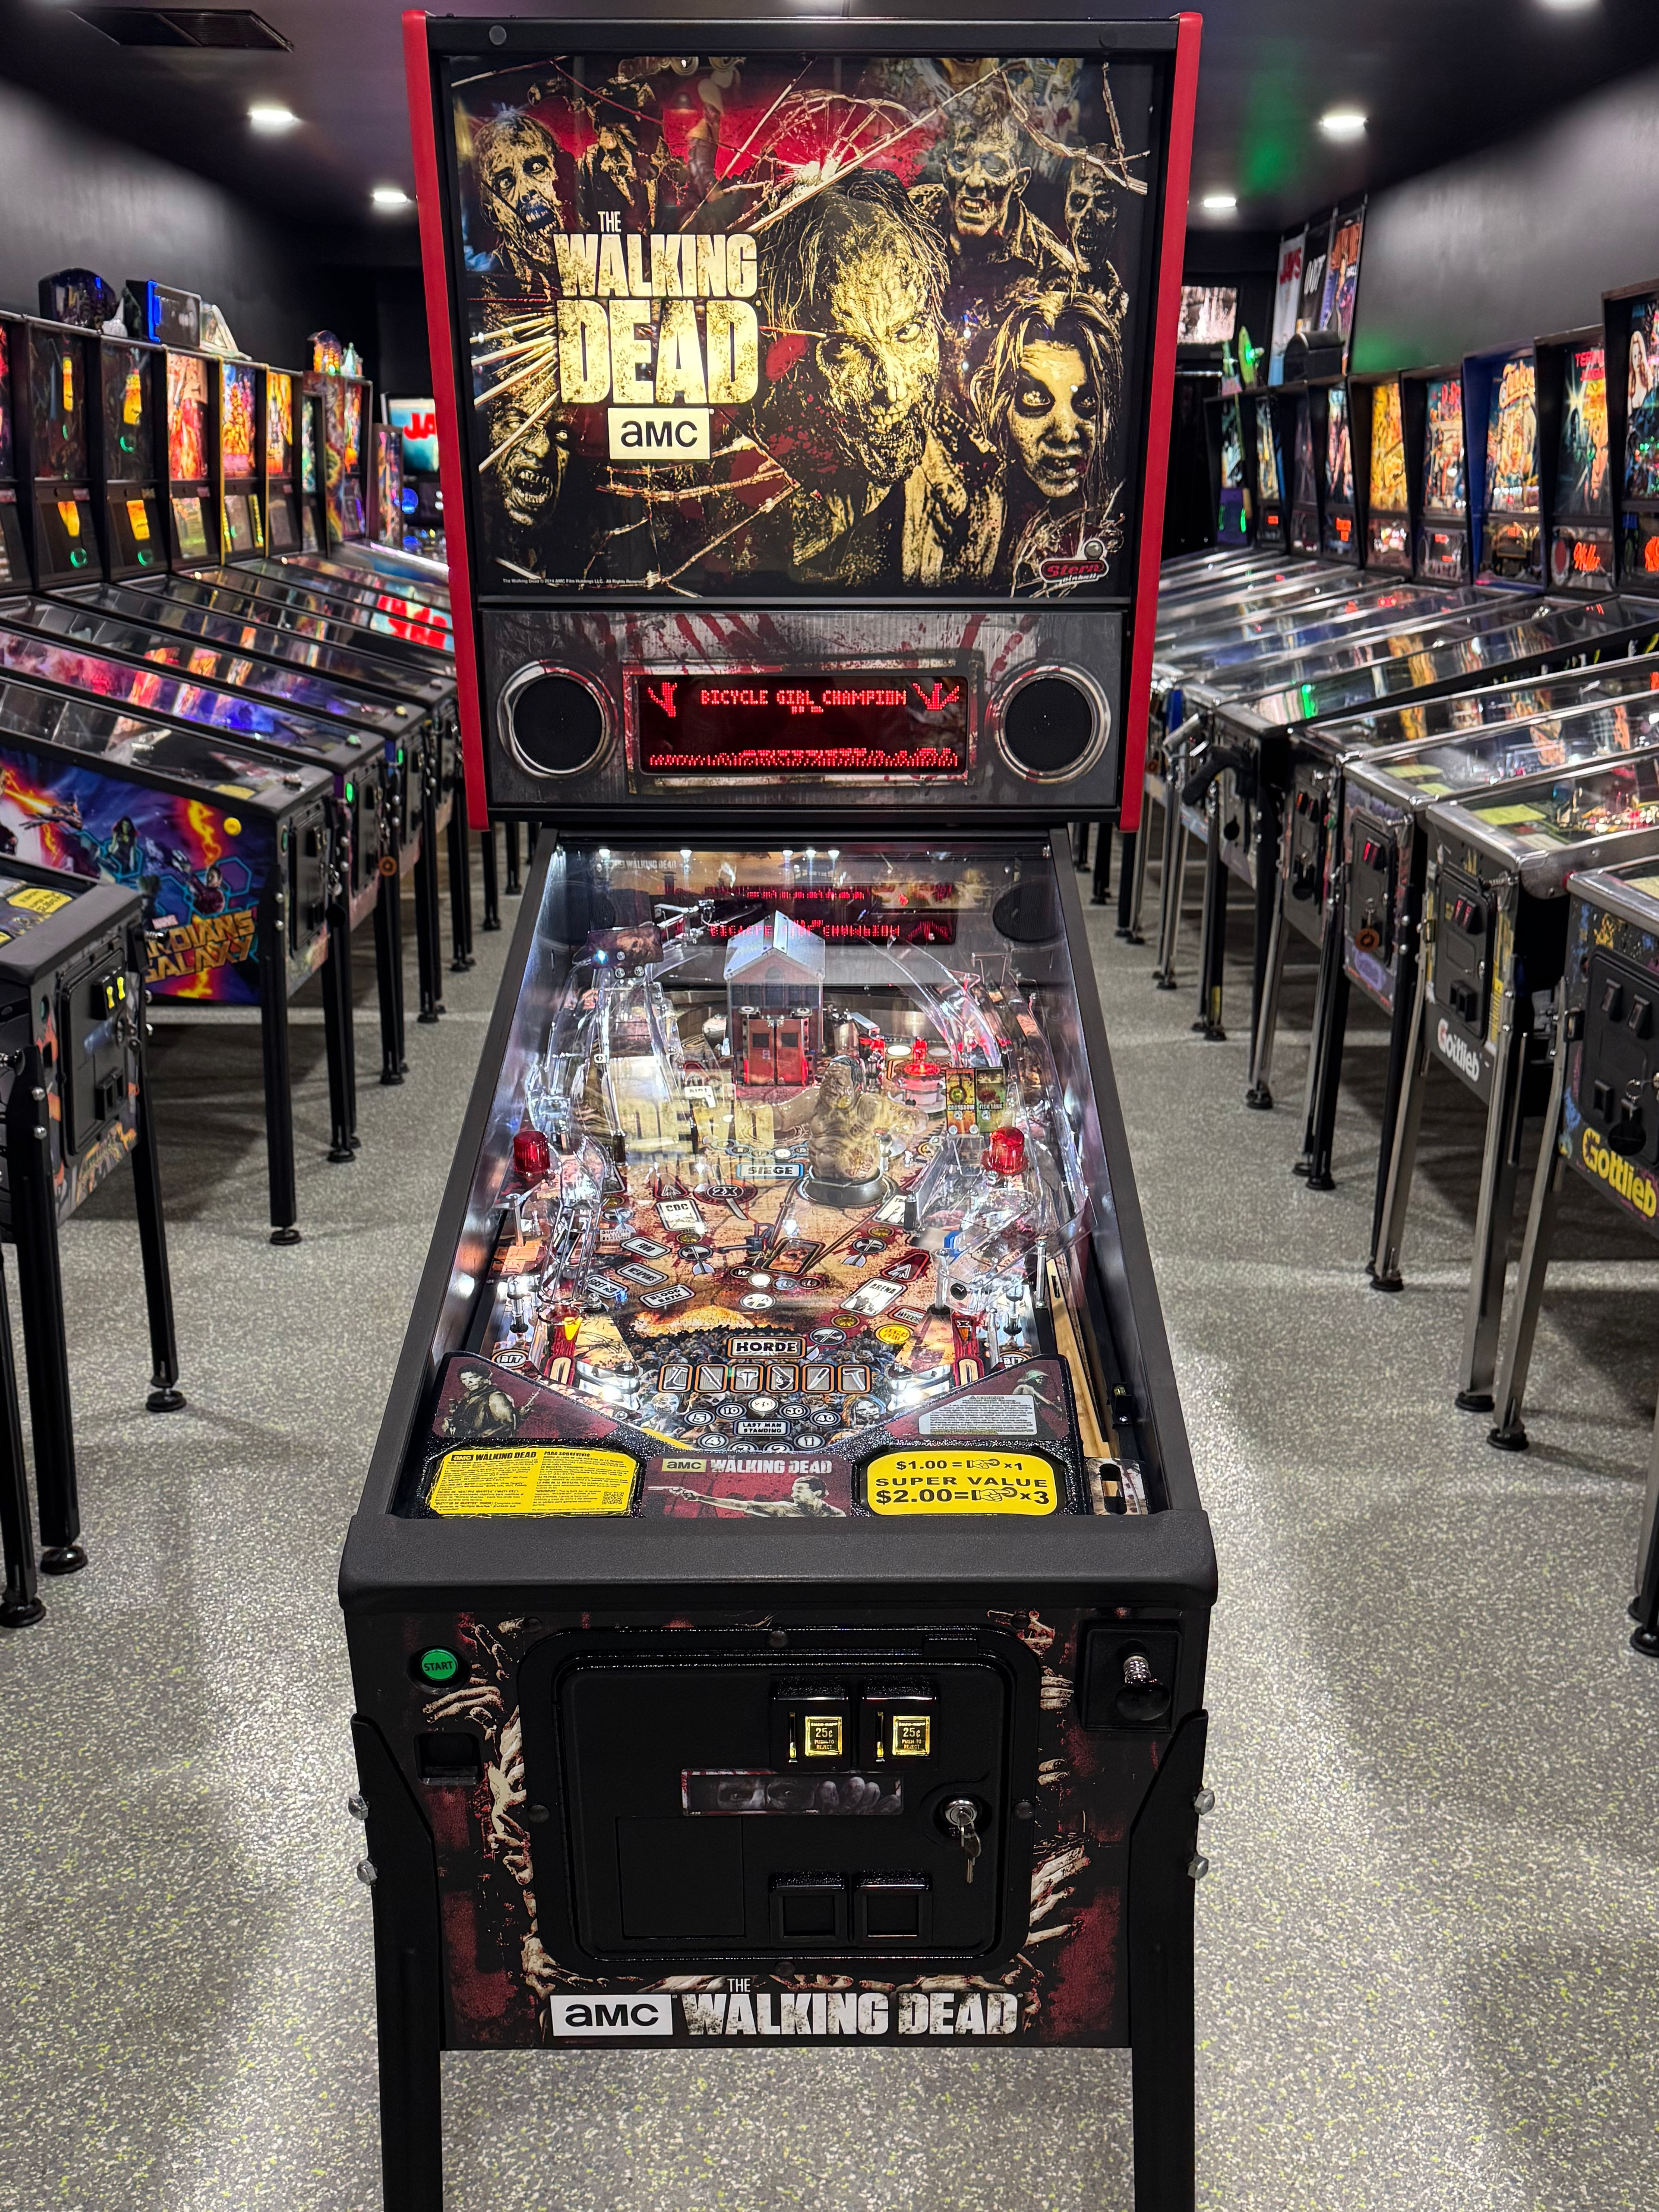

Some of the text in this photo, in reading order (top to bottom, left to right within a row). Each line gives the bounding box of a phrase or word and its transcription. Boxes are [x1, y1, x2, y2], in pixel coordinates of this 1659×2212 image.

[598, 211, 621, 232] THE
[553, 234, 757, 297] WALKING
[557, 300, 759, 404] DEAD
[403, 413, 436, 440] JA
[1046, 564, 1104, 577] Stern
[701, 690, 907, 705] BICYCLE GIRL CHAMPION
[748, 1166, 793, 1175] SIEGE
[1582, 1127, 1657, 1218] Gottlieb
[712, 1187, 737, 1196] 2X
[665, 1203, 689, 1212] CDC
[636, 1242, 656, 1252] FOOD
[627, 1267, 657, 1282] WEAPONS
[869, 1283, 897, 1294] ARENA
[736, 1342, 797, 1352] HORDE
[501, 1355, 523, 1363] BIT
[1003, 1357, 1025, 1365] BIT
[723, 1407, 740, 1415] 10
[785, 1407, 804, 1415] 30
[692, 1413, 707, 1423] 5
[816, 1414, 834, 1422] 40
[706, 1436, 721, 1446] 4
[804, 1437, 814, 1446] 1
[711, 1460, 785, 1474] WALKING
[788, 1460, 832, 1474] DEAD
[896, 1460, 947, 1471] $1.00
[876, 1477, 1048, 1488] SUPER VALUE
[424, 1660, 453, 1671] START
[816, 1728, 833, 1738] 25¢
[903, 1728, 921, 1738] 25¢
[727, 1978, 750, 1993] THE
[682, 1993, 889, 2035] WALKING
[898, 1993, 1017, 2035] DEAD
